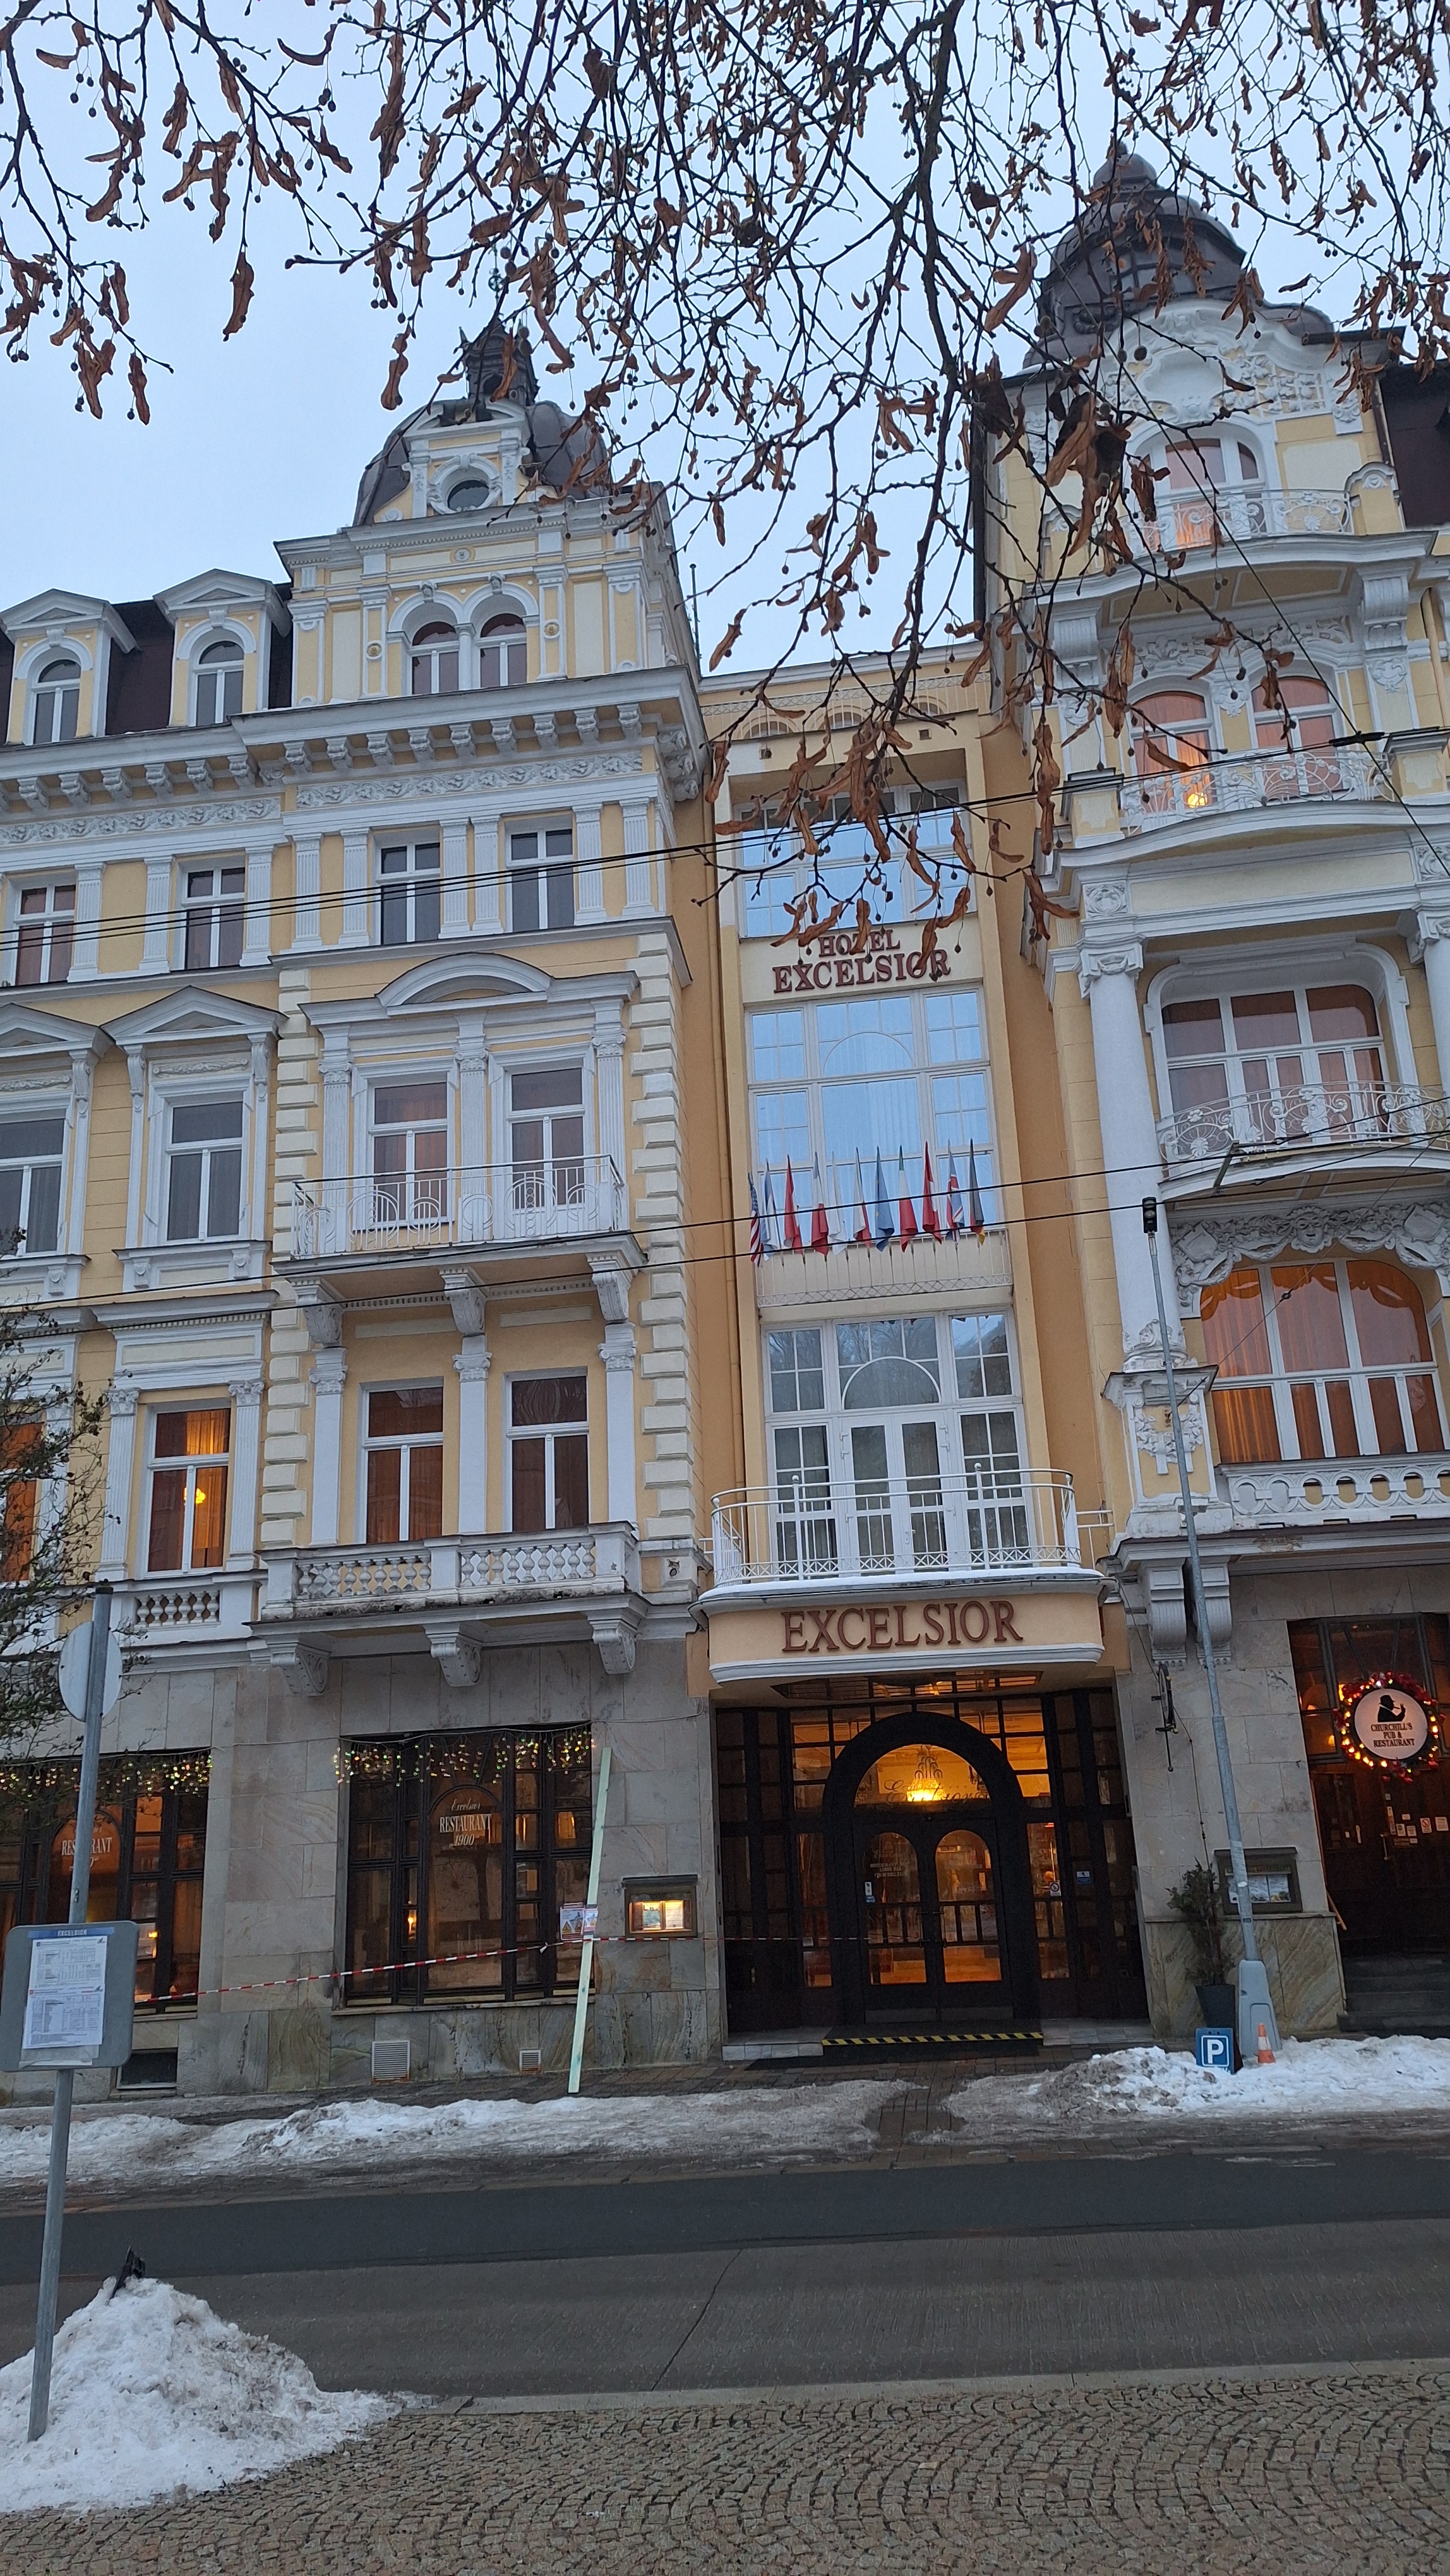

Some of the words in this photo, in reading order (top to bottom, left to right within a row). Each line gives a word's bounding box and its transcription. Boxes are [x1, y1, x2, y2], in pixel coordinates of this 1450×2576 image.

[773, 949, 951, 994] EXCELSIOR
[781, 1601, 1023, 1652] EXCELSIOR
[1371, 1722, 1413, 1732] CHURCHILL'S
[1373, 1739, 1415, 1747] RESTAURANT
[440, 1813, 491, 1834] RESTAURANT
[62, 1837, 112, 1856] RESRANT
[453, 1834, 474, 1846] 1900
[1207, 2039, 1224, 2064] P
